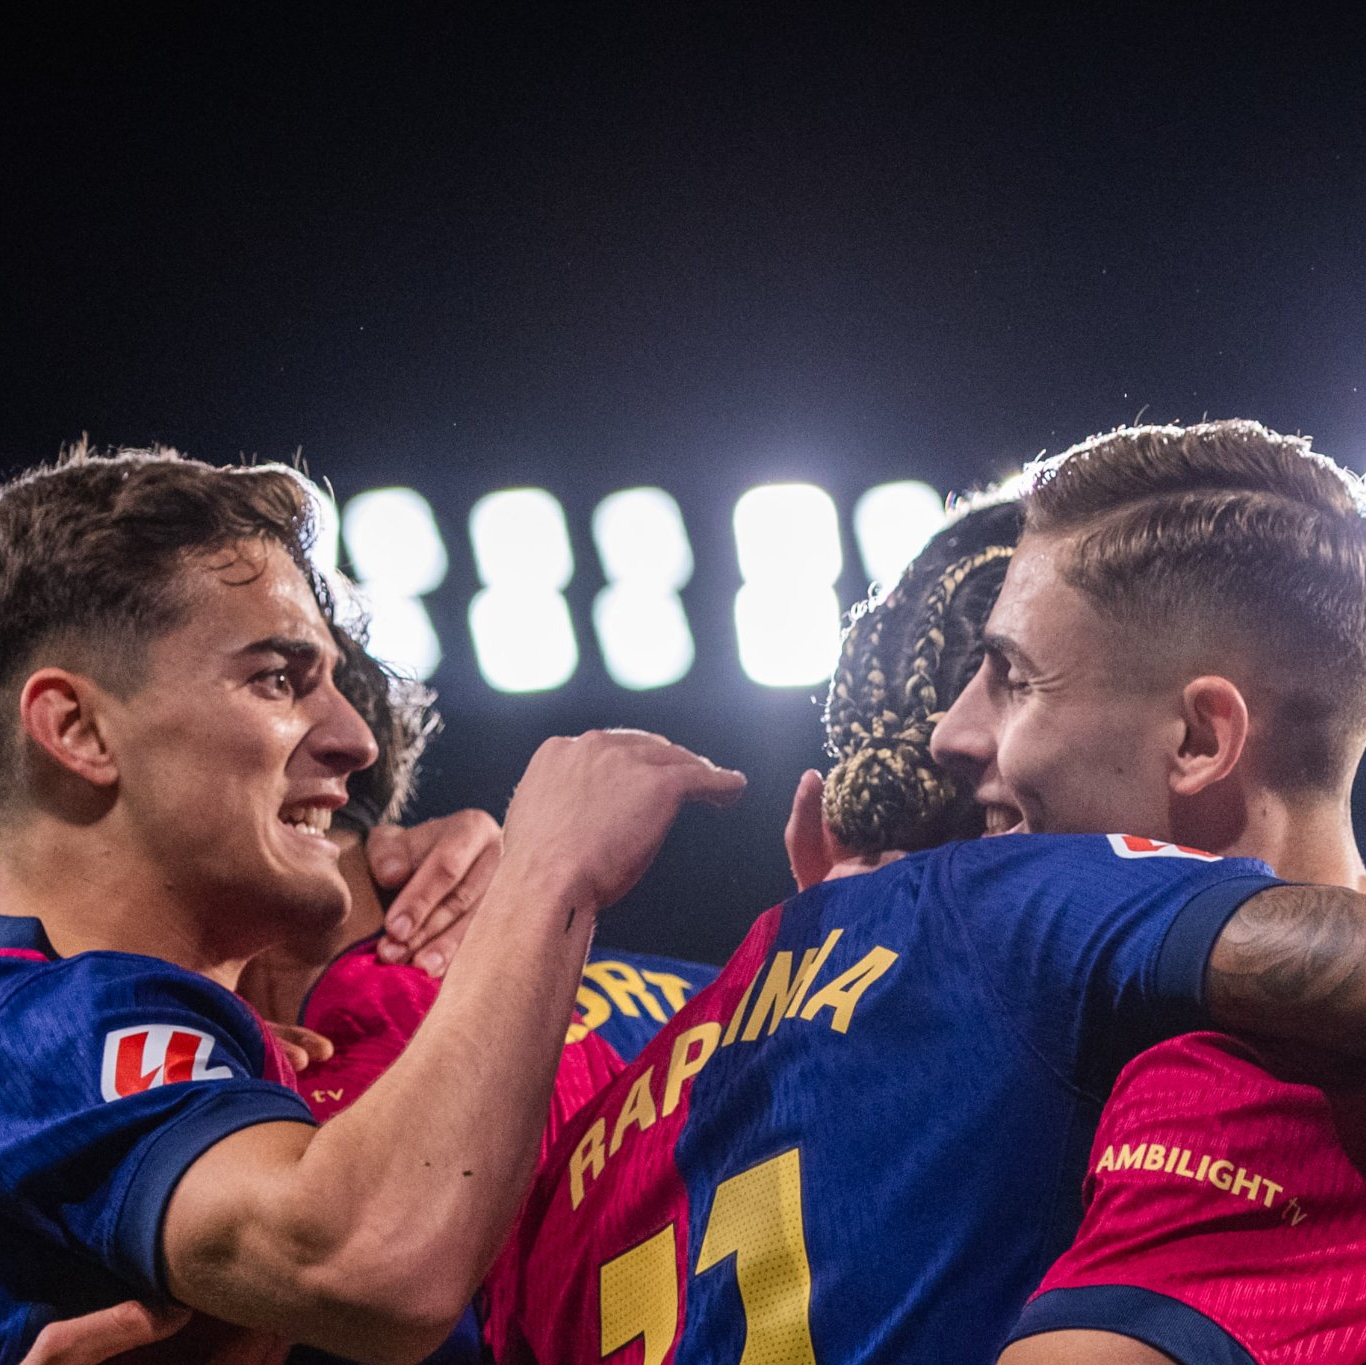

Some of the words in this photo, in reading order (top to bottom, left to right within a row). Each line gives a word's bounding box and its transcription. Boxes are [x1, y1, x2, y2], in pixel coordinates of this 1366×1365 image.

[310, 1088, 344, 1103] tv
[1095, 1143, 1284, 1208] AMBILIGHT
[1281, 1197, 1308, 1227] tv
